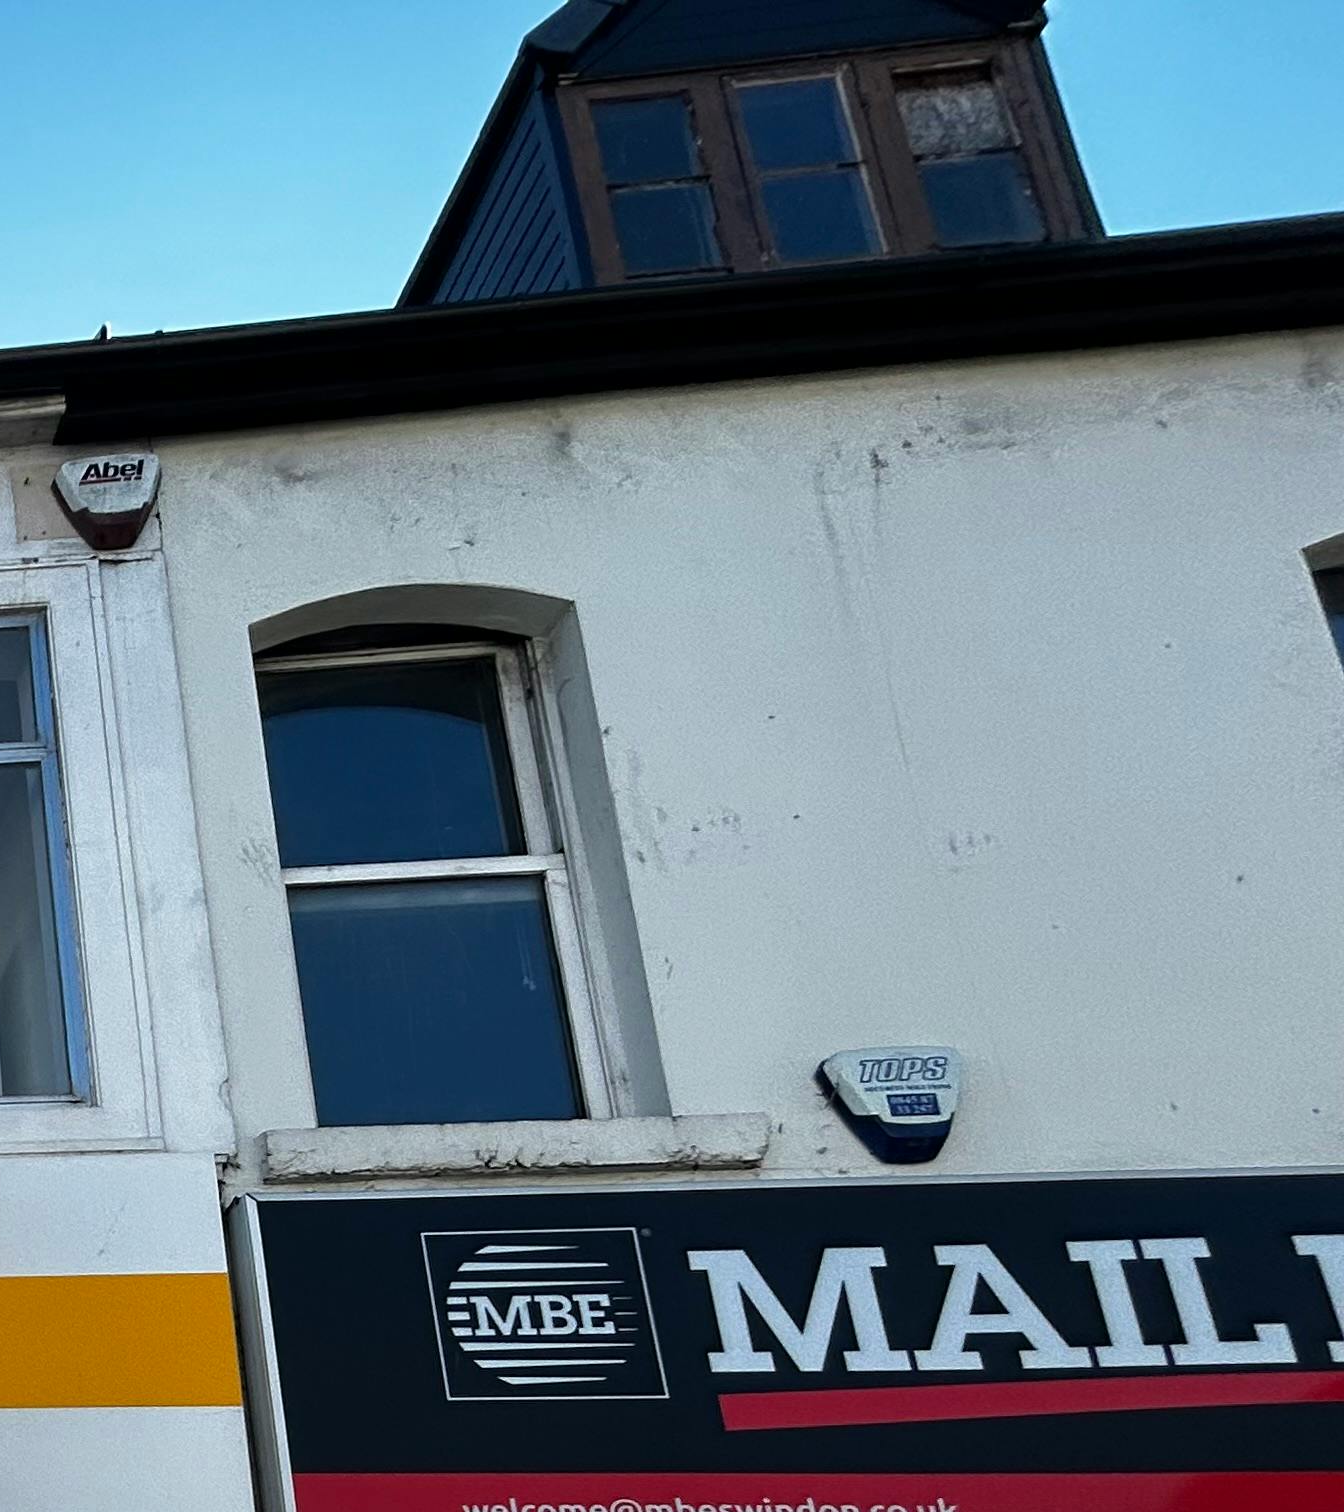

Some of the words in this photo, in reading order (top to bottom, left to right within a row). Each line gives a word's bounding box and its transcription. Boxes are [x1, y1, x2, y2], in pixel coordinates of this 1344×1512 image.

[81, 459, 144, 480] Abel
[860, 1056, 948, 1083] TOPS
[471, 1291, 616, 1337] MBE
[687, 1236, 1300, 1374] MAIL
